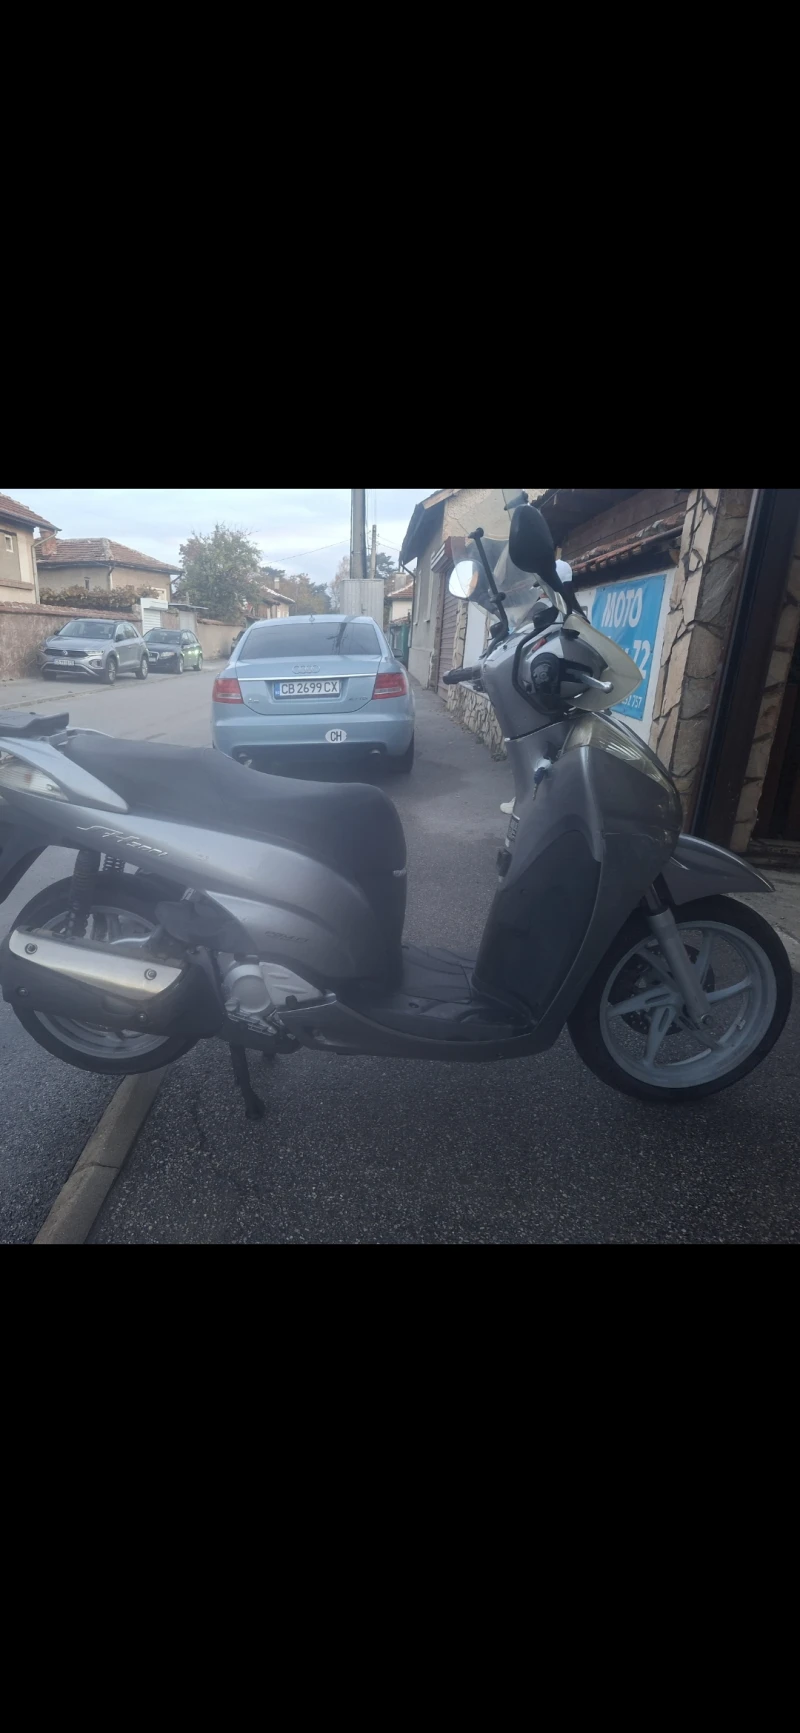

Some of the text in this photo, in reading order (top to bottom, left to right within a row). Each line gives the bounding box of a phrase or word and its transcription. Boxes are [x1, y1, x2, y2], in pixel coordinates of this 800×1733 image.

[601, 588, 643, 628] MOTO
[632, 640, 651, 679] 72
[281, 681, 338, 695] CB 2699 CX
[330, 731, 342, 742] CH
